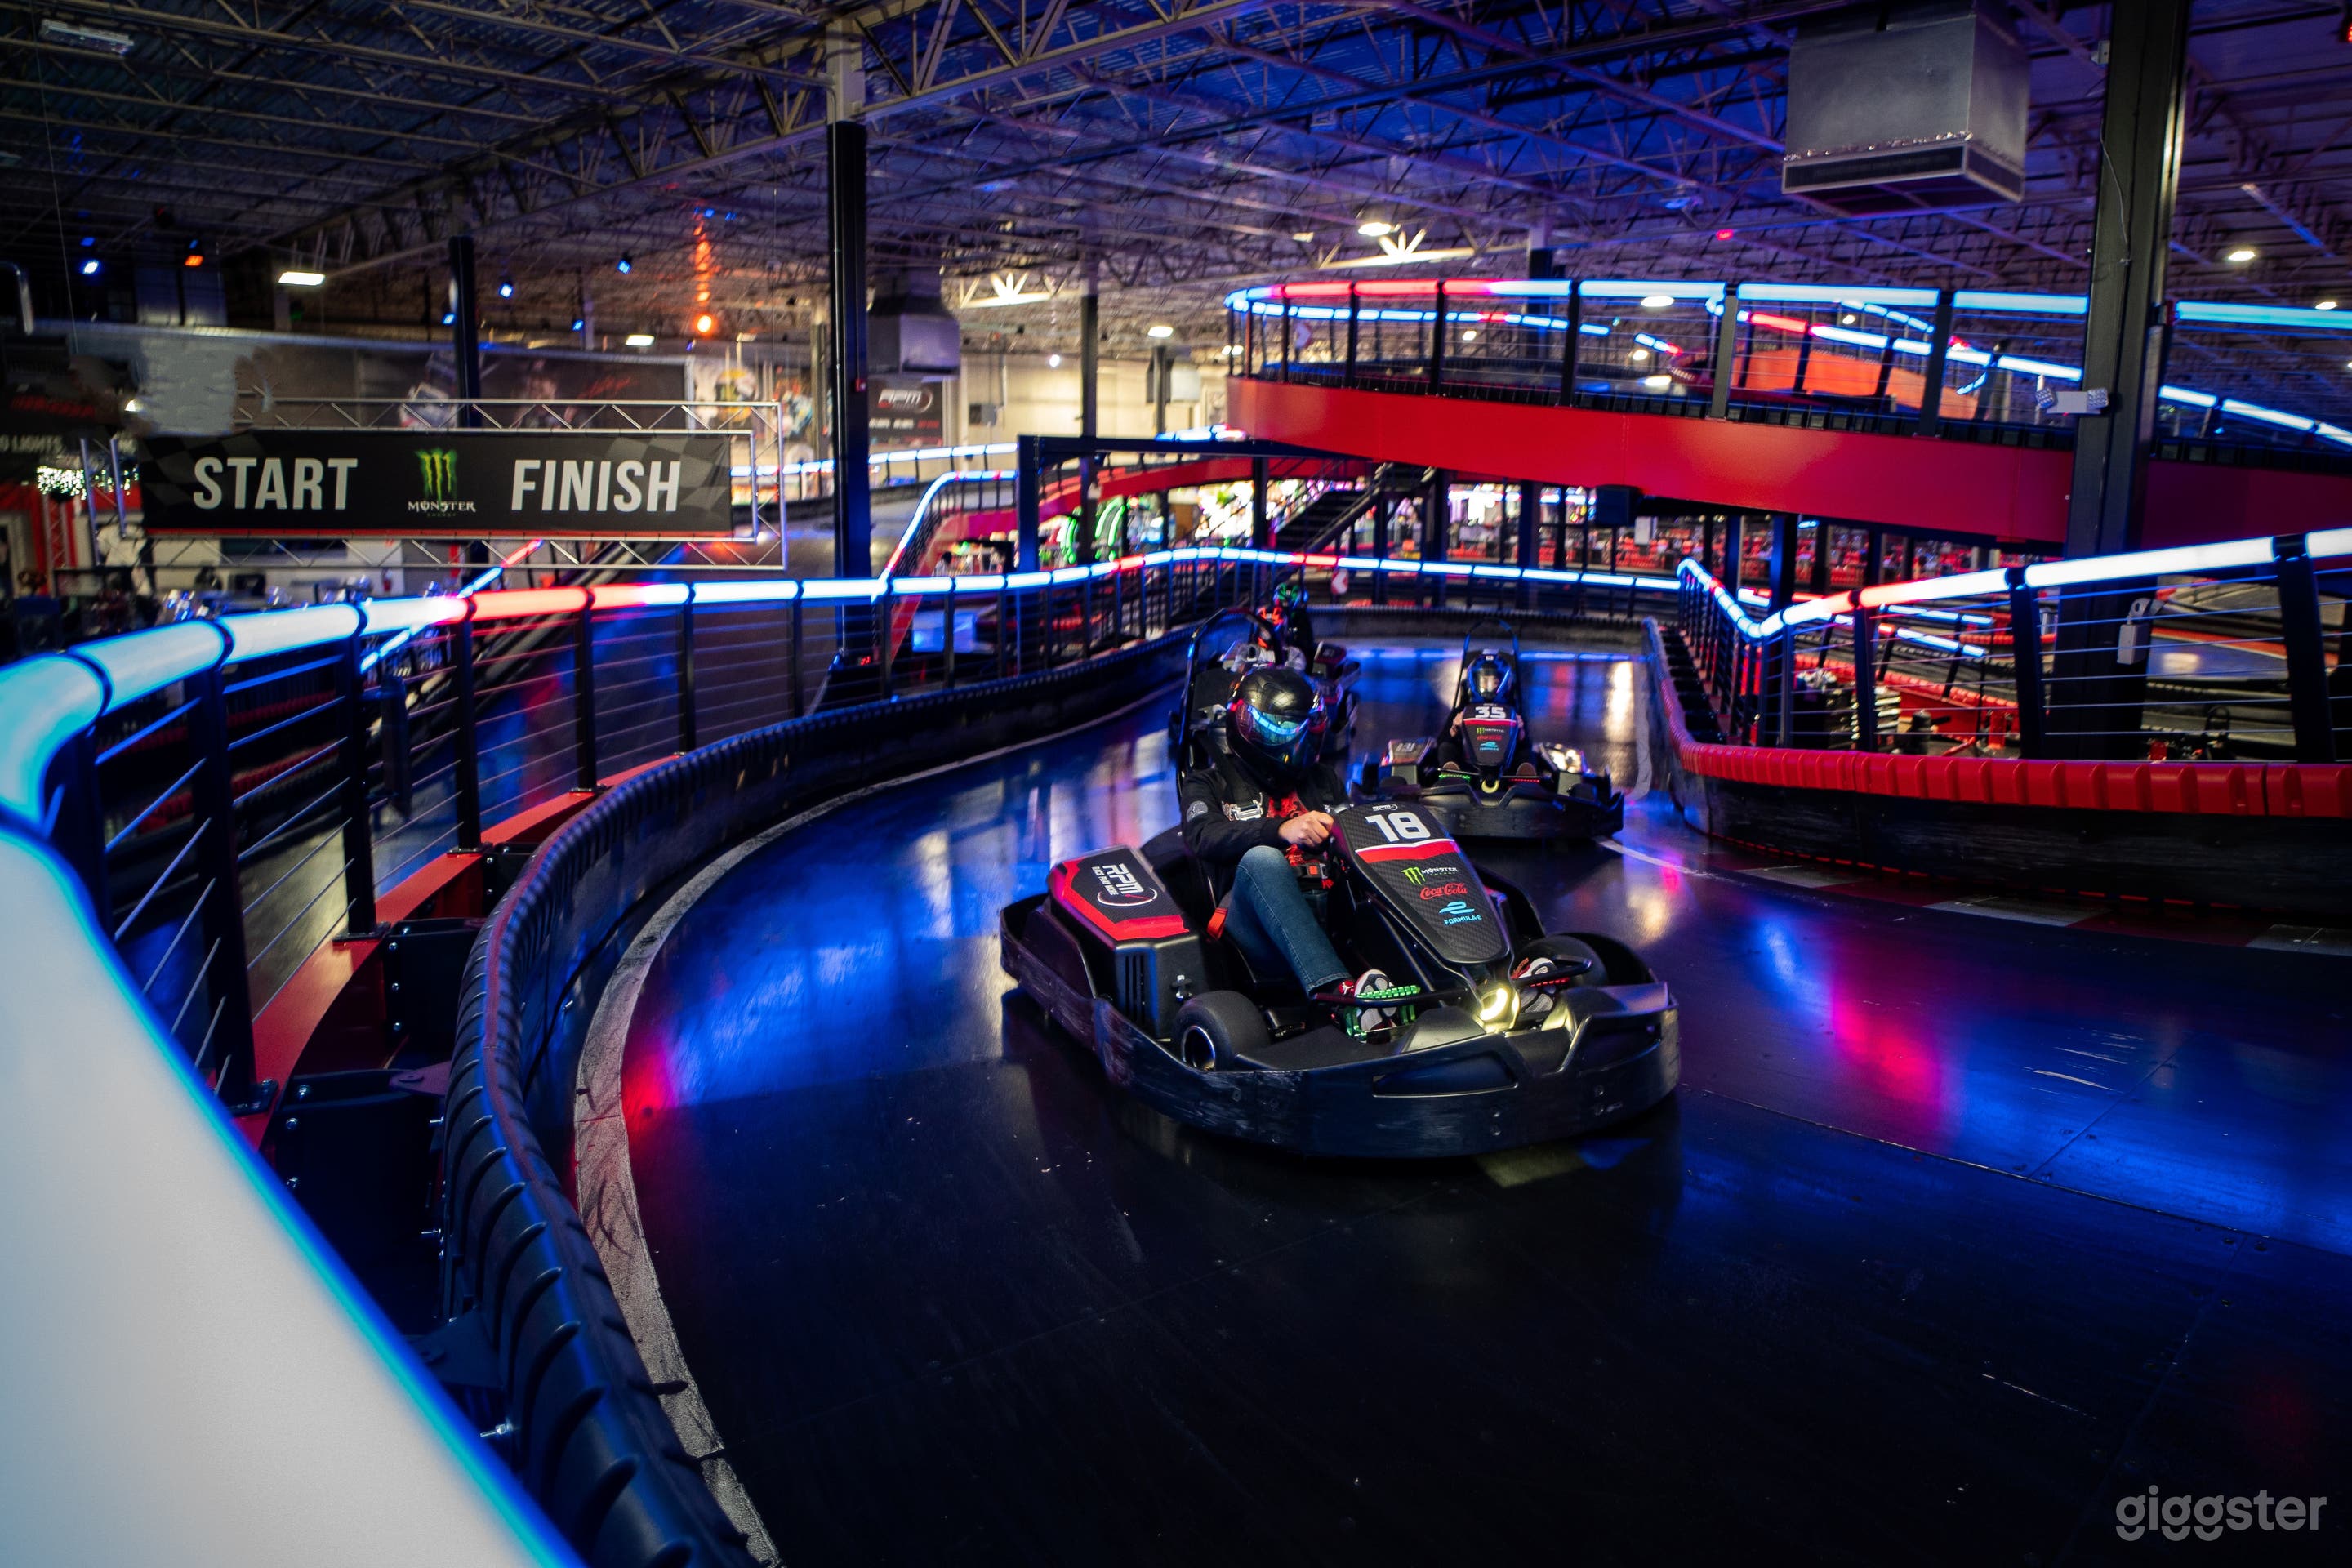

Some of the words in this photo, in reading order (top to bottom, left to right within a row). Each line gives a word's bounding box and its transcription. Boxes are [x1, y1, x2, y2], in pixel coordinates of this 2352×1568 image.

[193, 456, 359, 510] START
[511, 459, 682, 513] FINISH
[408, 500, 476, 513] MONSTER
[1475, 706, 1507, 719] 35
[1365, 811, 1431, 843] 18
[1103, 863, 1144, 893] RPM
